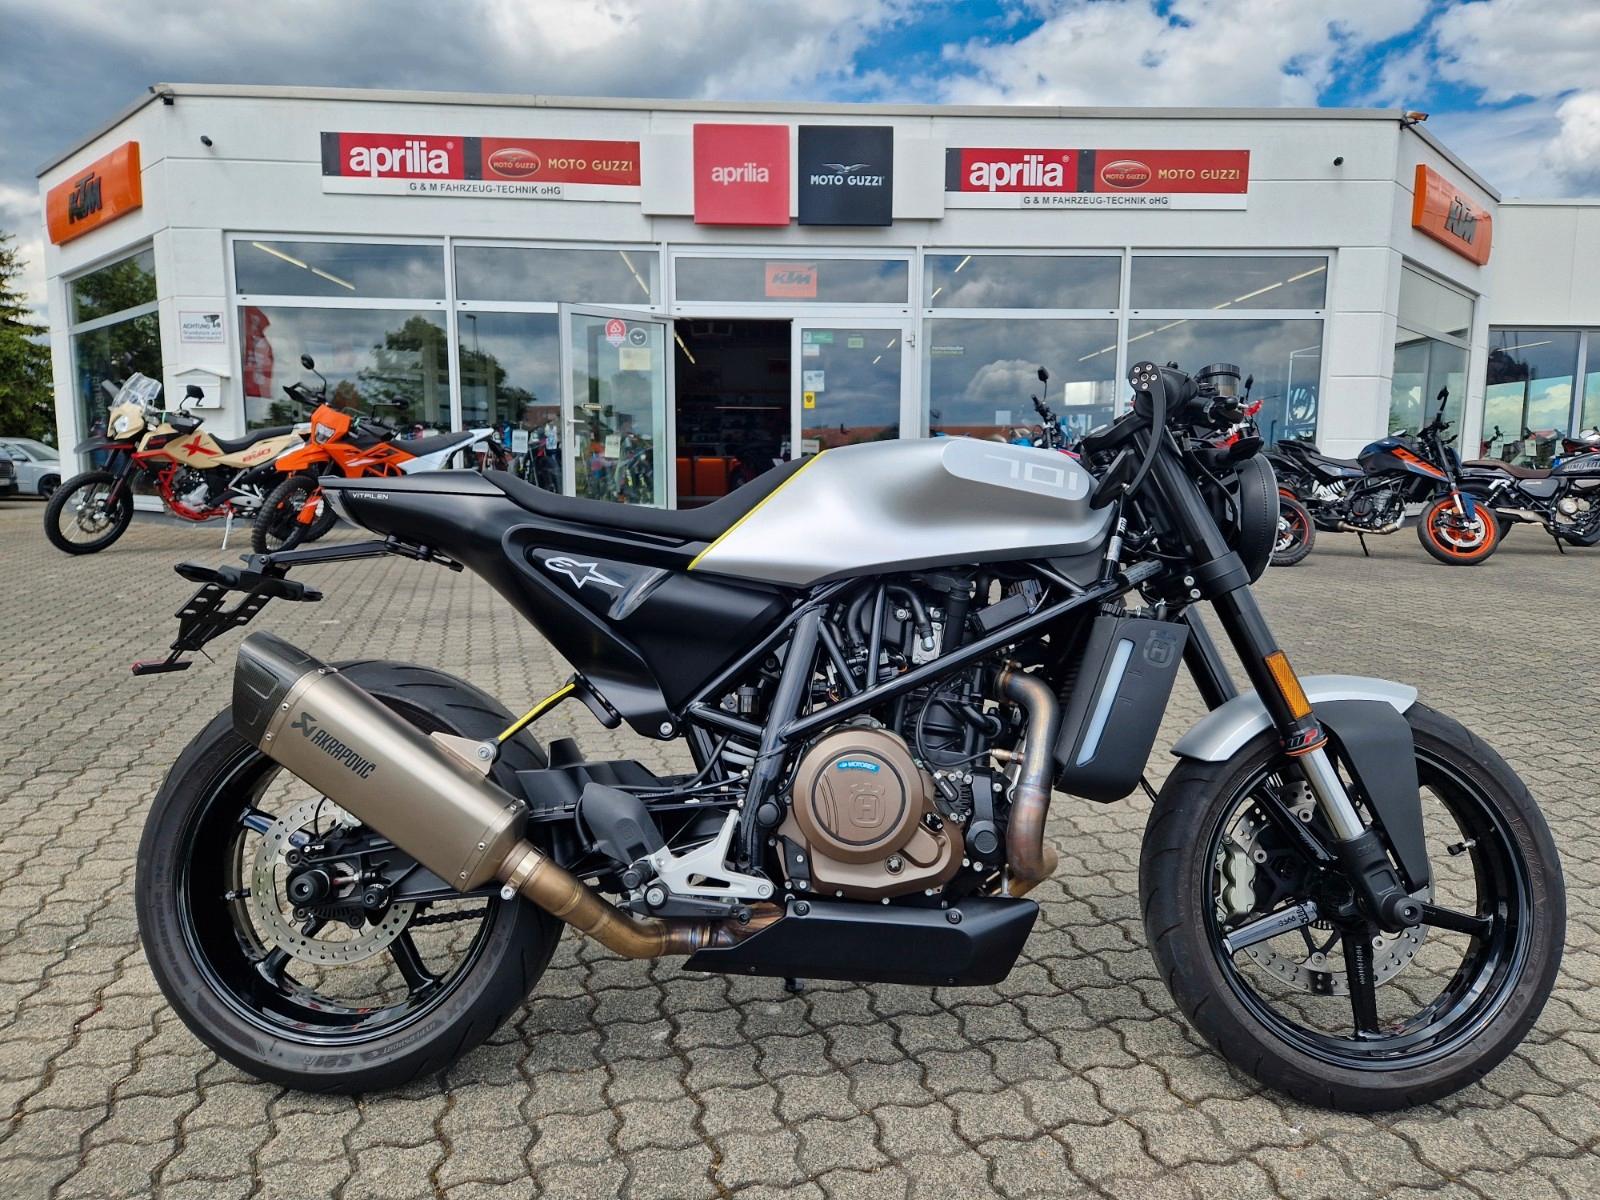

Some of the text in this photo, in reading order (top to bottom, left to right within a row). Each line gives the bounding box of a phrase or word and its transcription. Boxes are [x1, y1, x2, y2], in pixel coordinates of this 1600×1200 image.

[349, 140, 450, 178] aprilia
[493, 161, 536, 170] MOTO GUZZI
[548, 158, 633, 172] MOTO GUZZI
[711, 162, 769, 186] aprilia
[969, 155, 1064, 191] aprilia
[1158, 169, 1240, 180] MOTO GUZZI
[810, 174, 882, 187] MOTO GUZZI
[409, 182, 561, 195] G & M FAHRZEUG-TECHNIK oHG
[68, 171, 102, 225] KTM
[1023, 196, 1169, 205] G & M FAHRZEUG-TECHNIK oHG
[1444, 195, 1477, 245] KTM
[984, 453, 1078, 491] 701
[352, 492, 389, 500] VITPILEN
